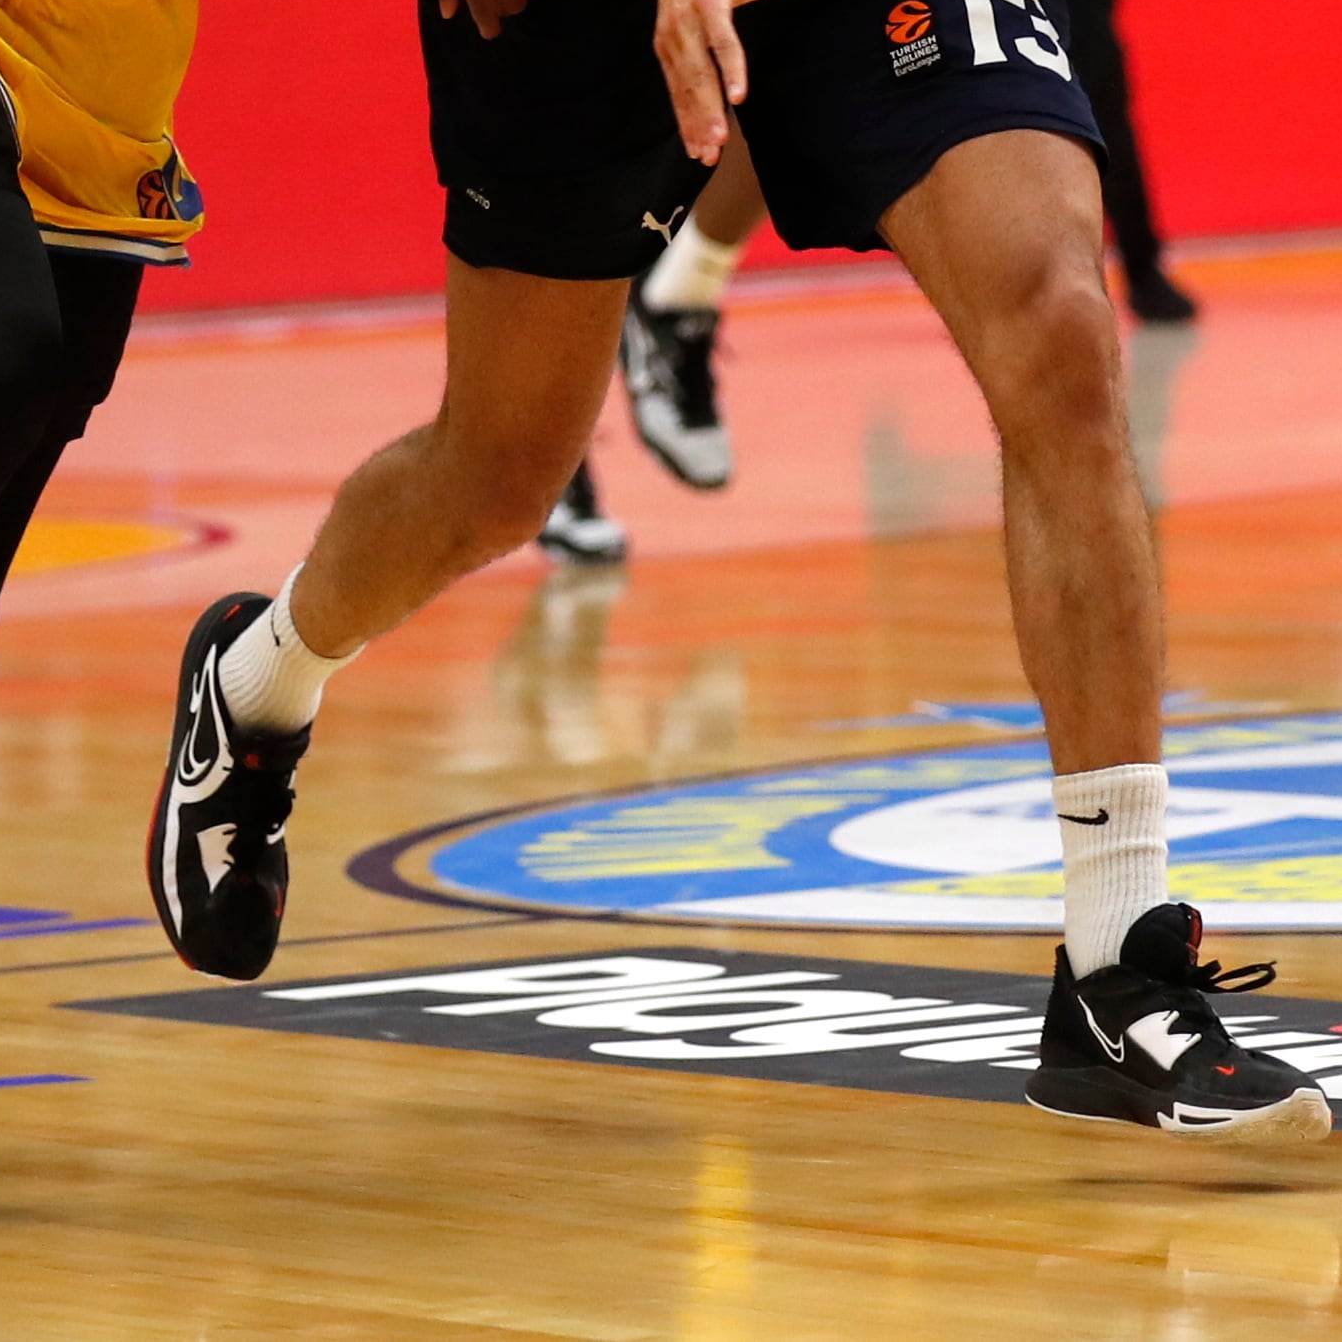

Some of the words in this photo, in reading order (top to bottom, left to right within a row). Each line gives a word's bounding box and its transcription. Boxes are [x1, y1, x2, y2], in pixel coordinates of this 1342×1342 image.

[889, 34, 936, 59] TURKISH
[893, 44, 939, 68] AIRLINES
[895, 53, 941, 77] EuroLeague
